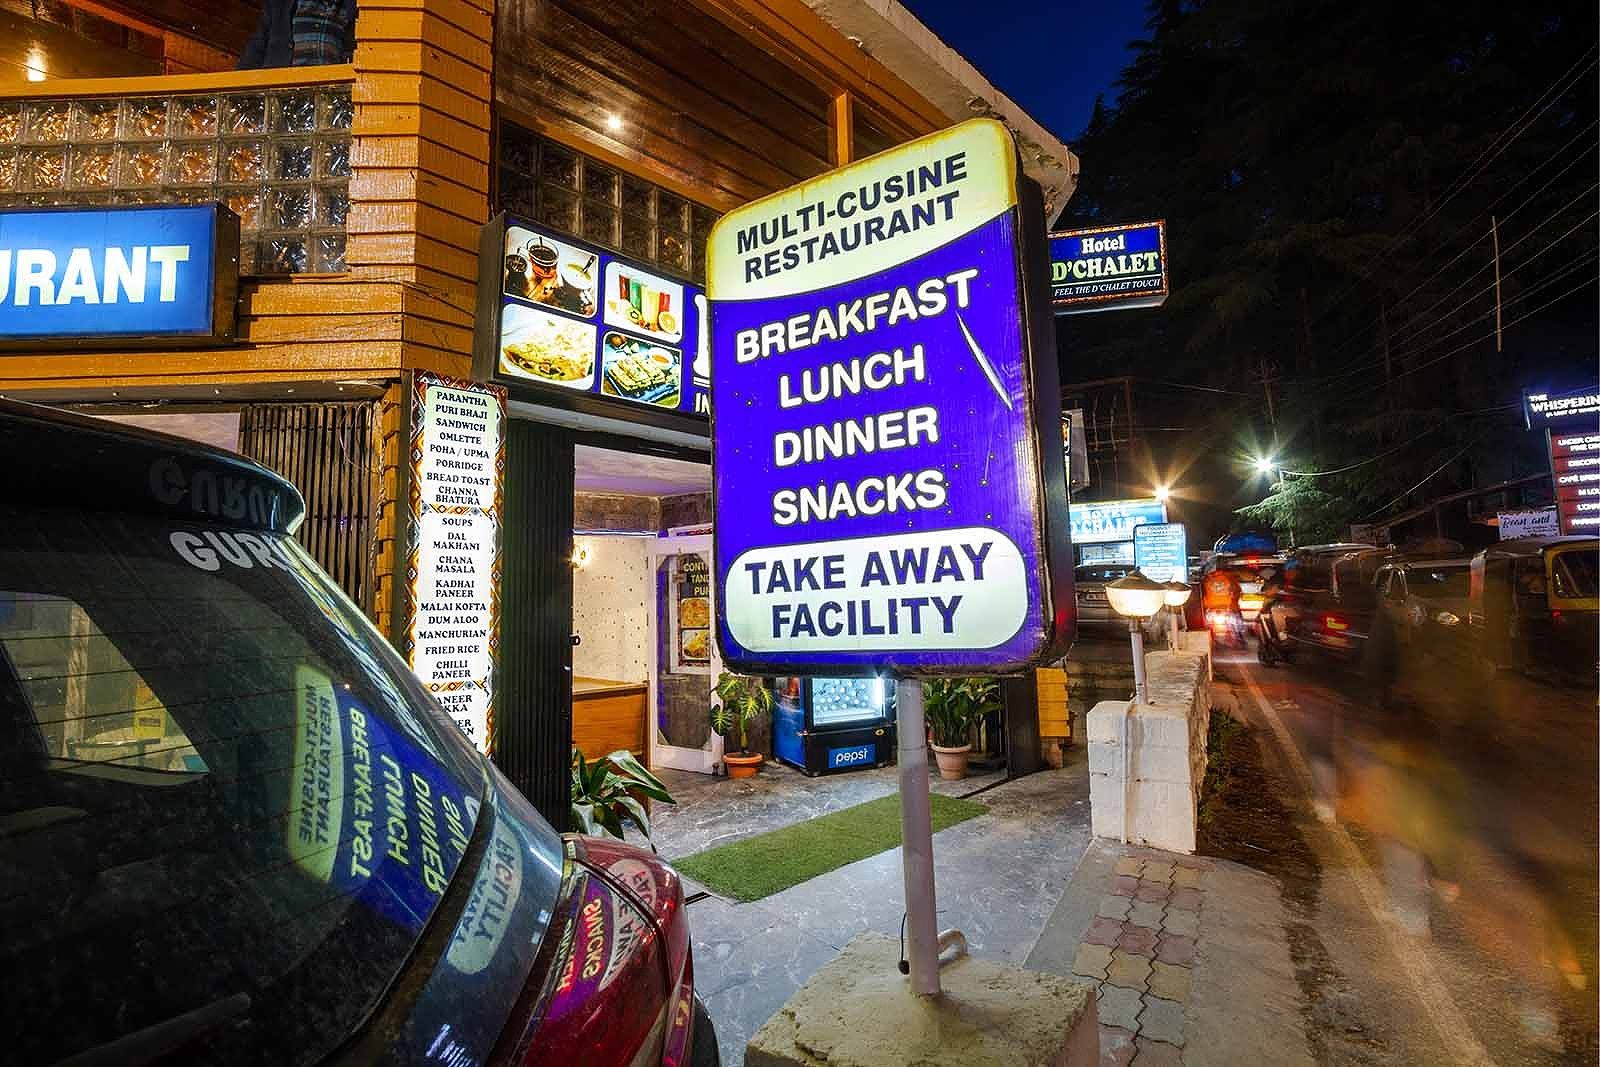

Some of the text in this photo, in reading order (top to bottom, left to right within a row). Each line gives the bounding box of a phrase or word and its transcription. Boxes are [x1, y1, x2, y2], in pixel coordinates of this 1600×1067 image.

[736, 152, 968, 254] MULTI-CUSINE
[744, 190, 961, 283] RESTAURANT
[1081, 234, 1126, 254] Hotel
[1051, 252, 1159, 281] D'CHALET
[1054, 279, 1161, 297] FEEL THE D'CHALET TOUCH
[736, 268, 979, 363] BREAKFAST
[780, 345, 926, 409] LUNCH
[436, 391, 488, 407] PARANTHA
[1530, 394, 1600, 412] WHISPERIN
[435, 405, 488, 419] PURI BHAJI
[435, 418, 486, 432] SANDWICH
[439, 432, 482, 445] OMLETTE
[774, 406, 939, 467] DINNER
[430, 444, 455, 456] POHA
[464, 448, 490, 459] UPMA
[435, 459, 484, 472] PORRIDGE
[427, 472, 491, 486] BREAD TOAST
[438, 486, 479, 497] CHANNA
[773, 469, 946, 526] SNACKS
[435, 494, 481, 506] BHATURA
[442, 517, 473, 527] SOUPS
[447, 532, 467, 541] DAL
[433, 541, 480, 551] MAKHANI
[439, 555, 473, 565] CHANA
[435, 565, 475, 574] MASALA
[744, 541, 993, 595] TAKE AWAY
[435, 580, 475, 589] KADHAI
[435, 589, 474, 598] PANEER
[420, 602, 487, 611] MALAI KOFTA
[428, 615, 479, 625] DUM ALOO
[772, 595, 963, 639] FACILITY
[418, 630, 487, 639] MANCHURIAN
[425, 645, 480, 655] FRIED RICE
[436, 660, 468, 669] CHILLI
[432, 669, 471, 680] PANEER
[437, 694, 473, 704] ANEER
[835, 748, 869, 765] pepsi
